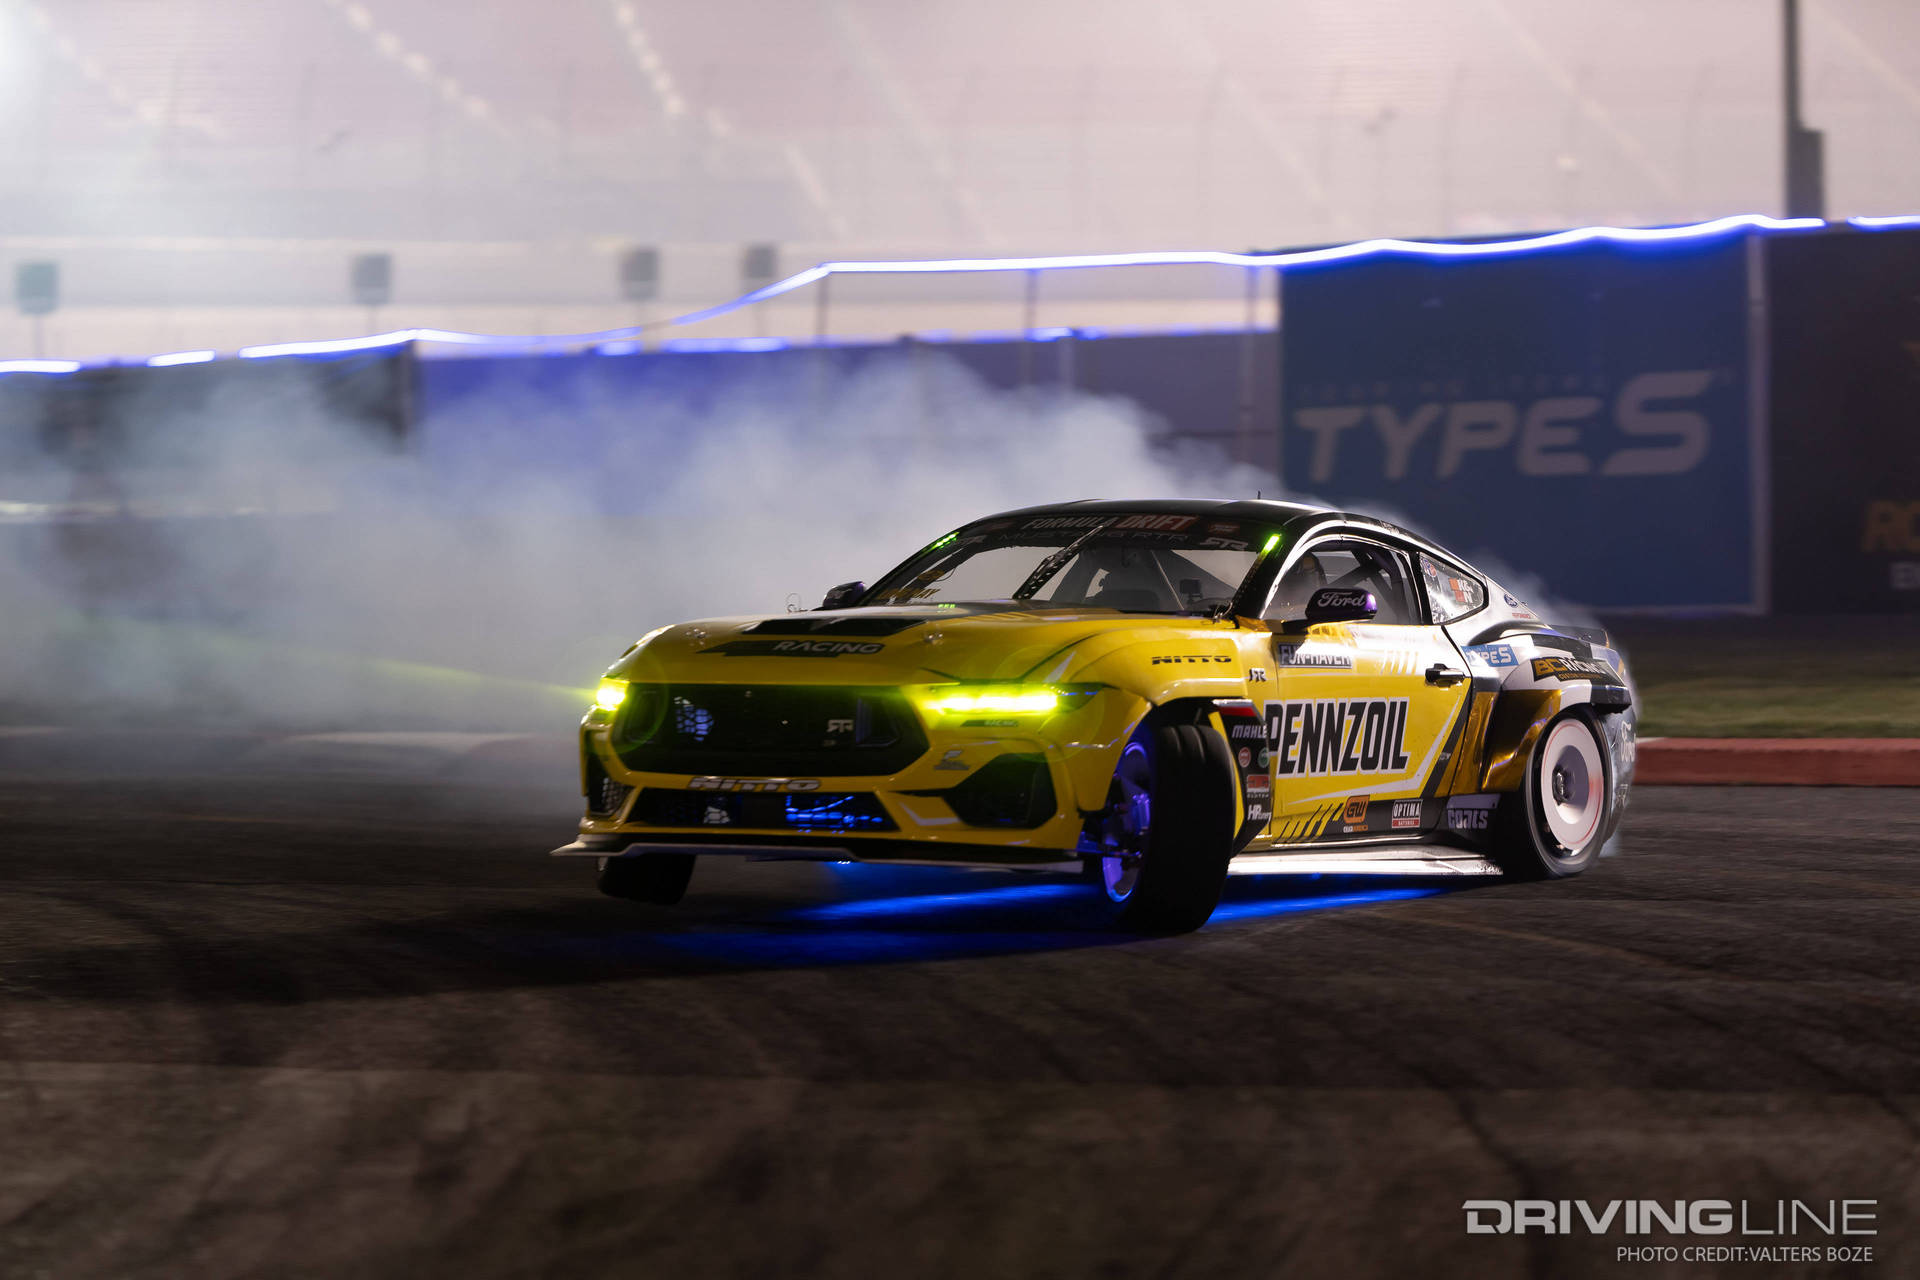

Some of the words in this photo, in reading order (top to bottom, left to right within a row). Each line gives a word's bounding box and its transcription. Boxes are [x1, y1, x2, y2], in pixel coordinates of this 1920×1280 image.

[1020, 516, 1115, 530] FORMULA
[1115, 515, 1196, 531] DRIFT
[1317, 591, 1366, 608] Ford
[773, 640, 884, 654] RACING
[1152, 655, 1232, 665] NITTO
[1231, 724, 1268, 739] MAHLE
[1264, 698, 1410, 776] PENNZOIL
[688, 776, 822, 791] NITTO
[1392, 802, 1420, 818] OPTIMA
